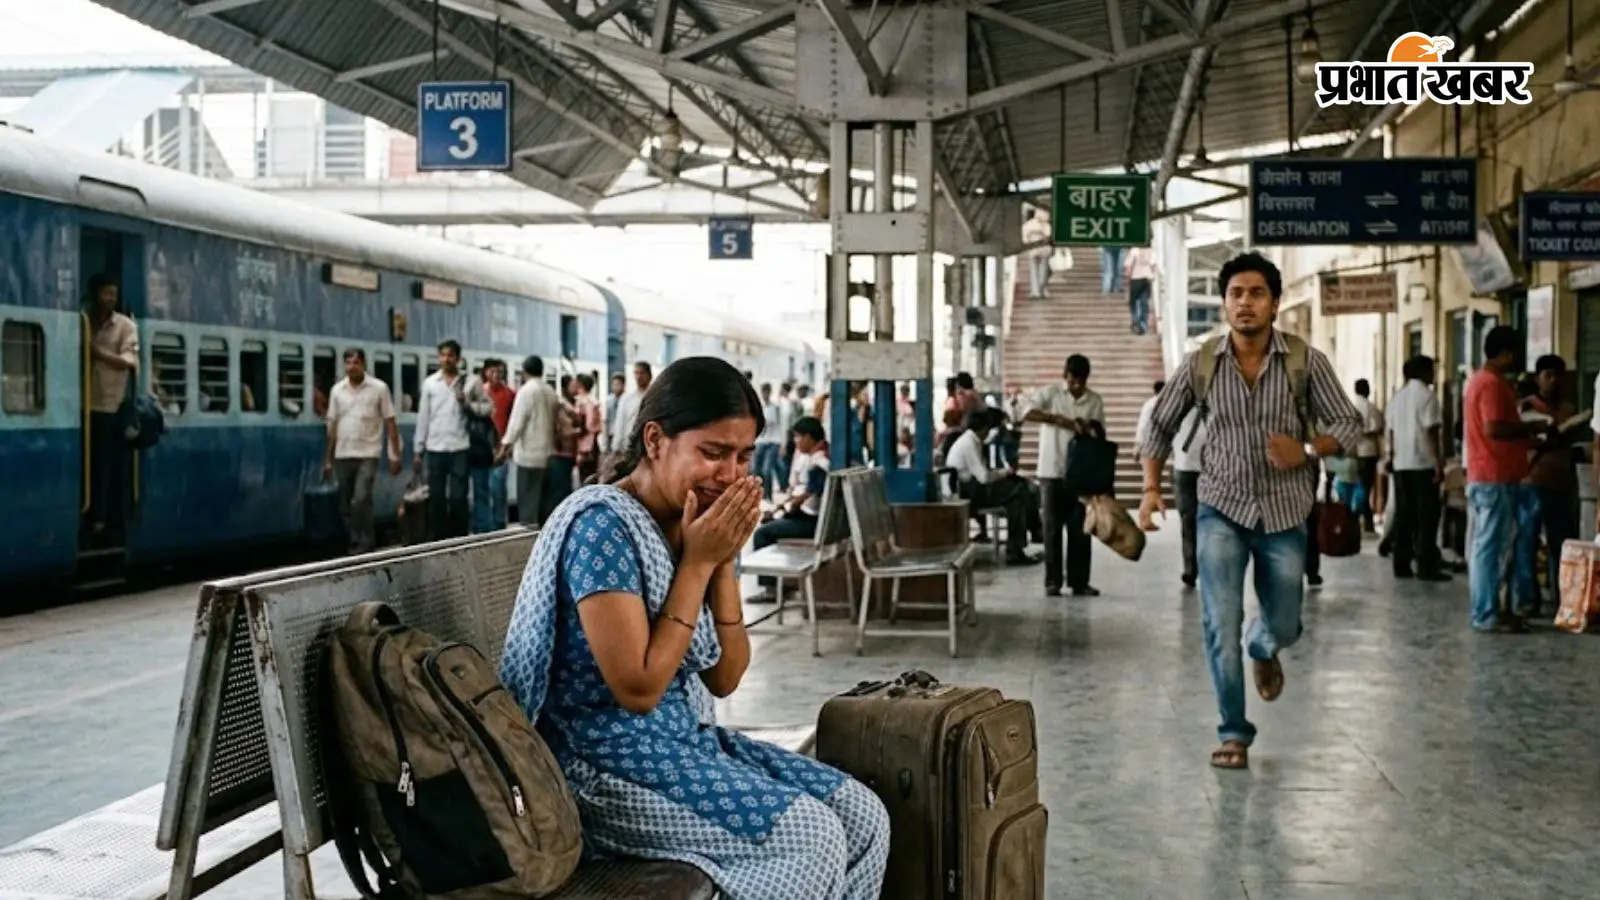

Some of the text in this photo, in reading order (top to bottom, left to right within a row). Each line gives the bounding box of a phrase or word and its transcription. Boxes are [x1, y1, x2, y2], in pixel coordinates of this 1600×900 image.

[424, 91, 503, 110] PLATFORM
[448, 116, 479, 159] 3
[1067, 185, 1135, 212] बाहर
[1070, 217, 1131, 239] EXIT
[722, 233, 738, 255] 5
[1573, 237, 1600, 252] COU
